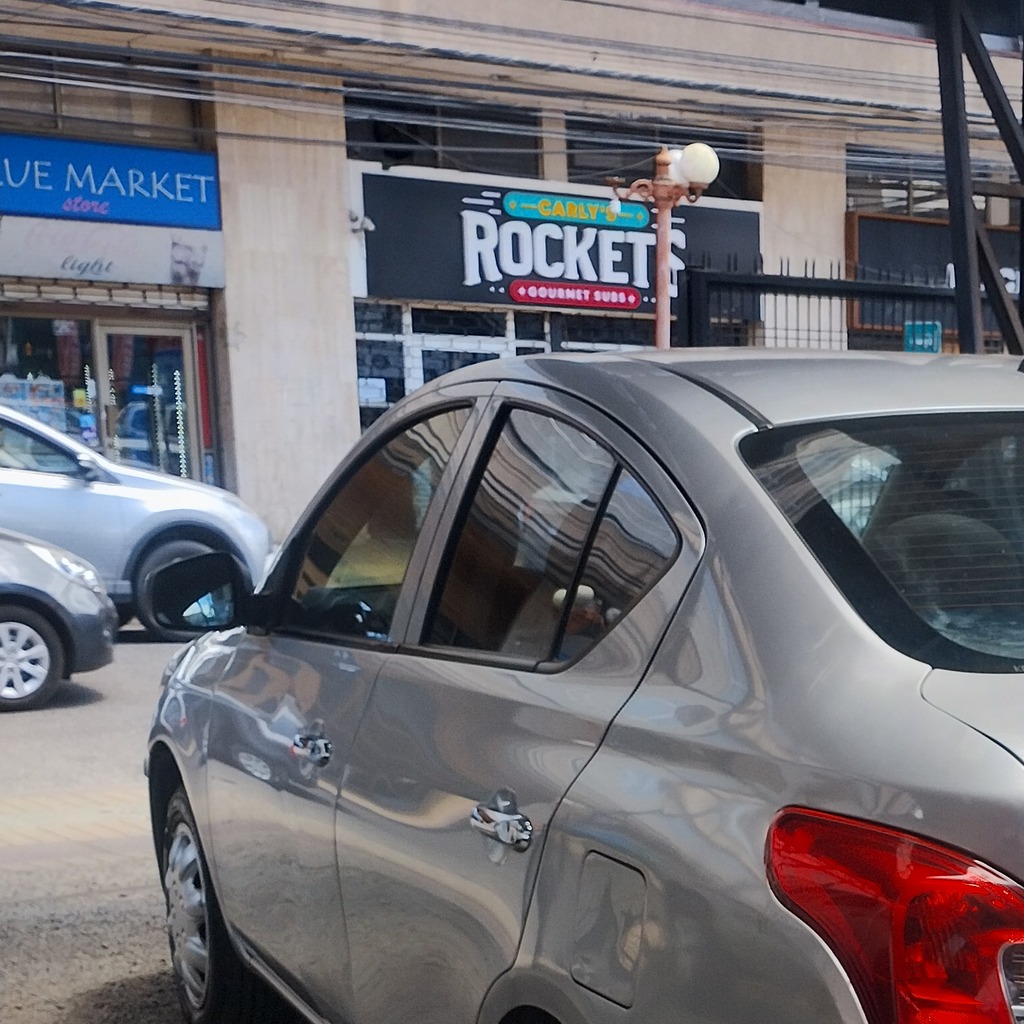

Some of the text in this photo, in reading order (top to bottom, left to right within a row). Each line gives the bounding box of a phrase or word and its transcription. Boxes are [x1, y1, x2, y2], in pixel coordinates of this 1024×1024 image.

[65, 163, 215, 203] MARKET
[61, 196, 110, 215] store
[537, 199, 617, 222] CARLY'S
[527, 285, 627, 304] GOURMET SUBS
